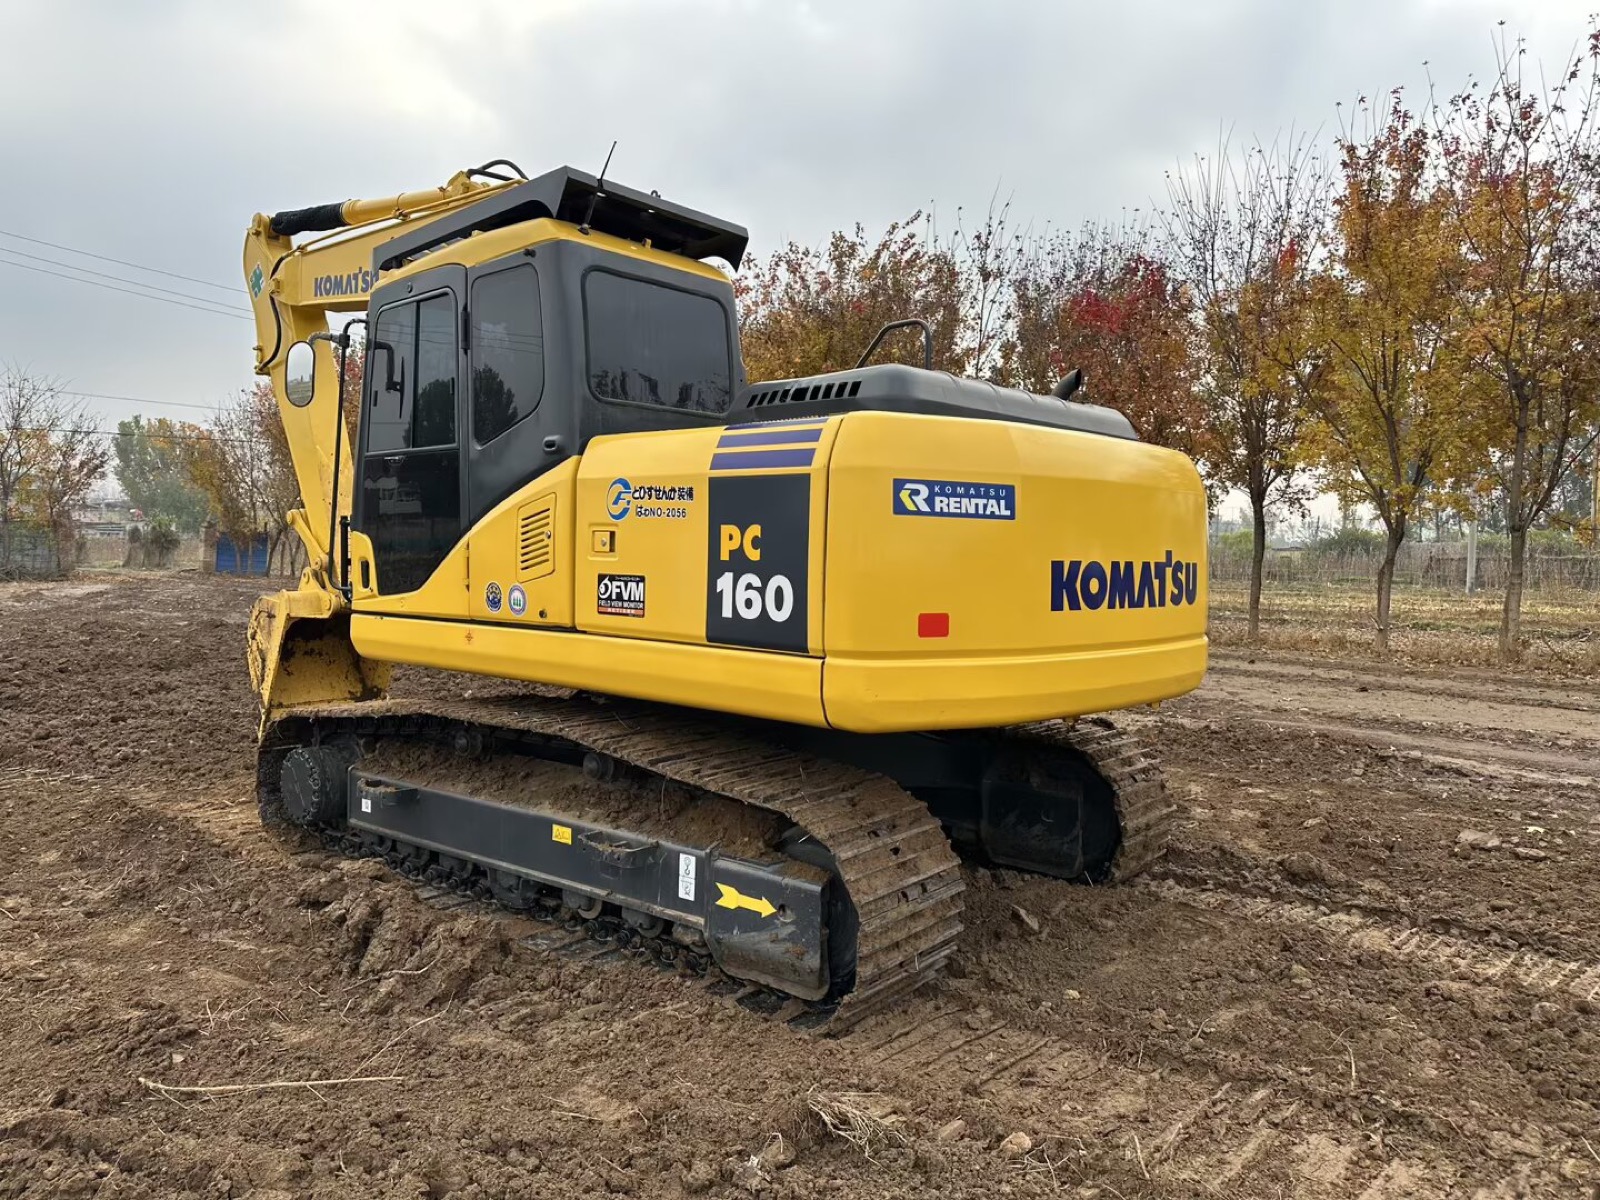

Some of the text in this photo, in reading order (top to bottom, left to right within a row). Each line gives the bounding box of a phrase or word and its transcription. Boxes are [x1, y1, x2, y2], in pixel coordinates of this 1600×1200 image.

[934, 485, 1006, 497] KOMATSU
[934, 496, 1011, 515] RENTAL
[719, 524, 762, 561] PC
[611, 581, 644, 601] FVM
[1050, 550, 1198, 612] KOMATSU
[716, 571, 794, 622] 160
